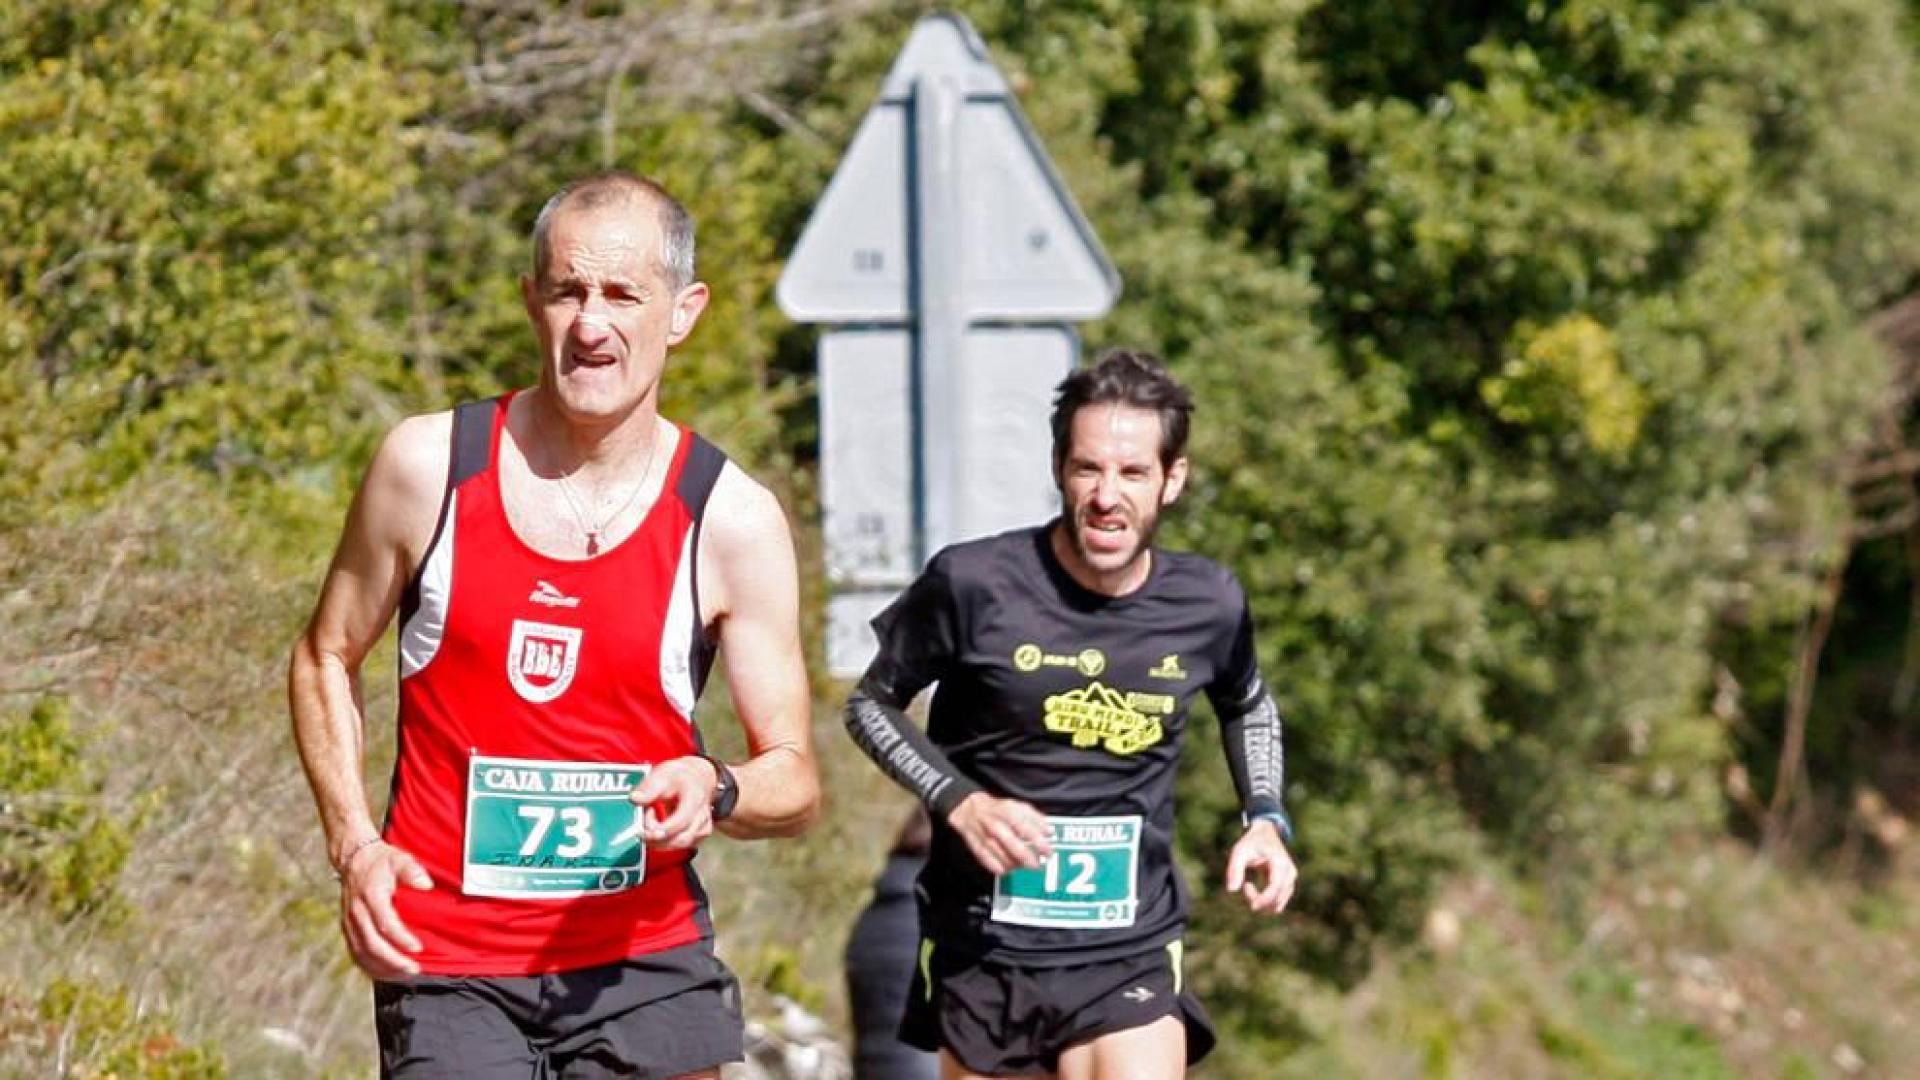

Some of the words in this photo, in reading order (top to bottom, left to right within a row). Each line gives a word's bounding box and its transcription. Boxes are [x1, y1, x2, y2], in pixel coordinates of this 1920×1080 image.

[1056, 713, 1116, 735] TRAIL
[484, 768, 545, 791] CAJA
[550, 772, 632, 792] RURAL
[518, 806, 593, 858] 73
[1062, 825, 1128, 842] RURAL
[1040, 852, 1097, 894] 12
